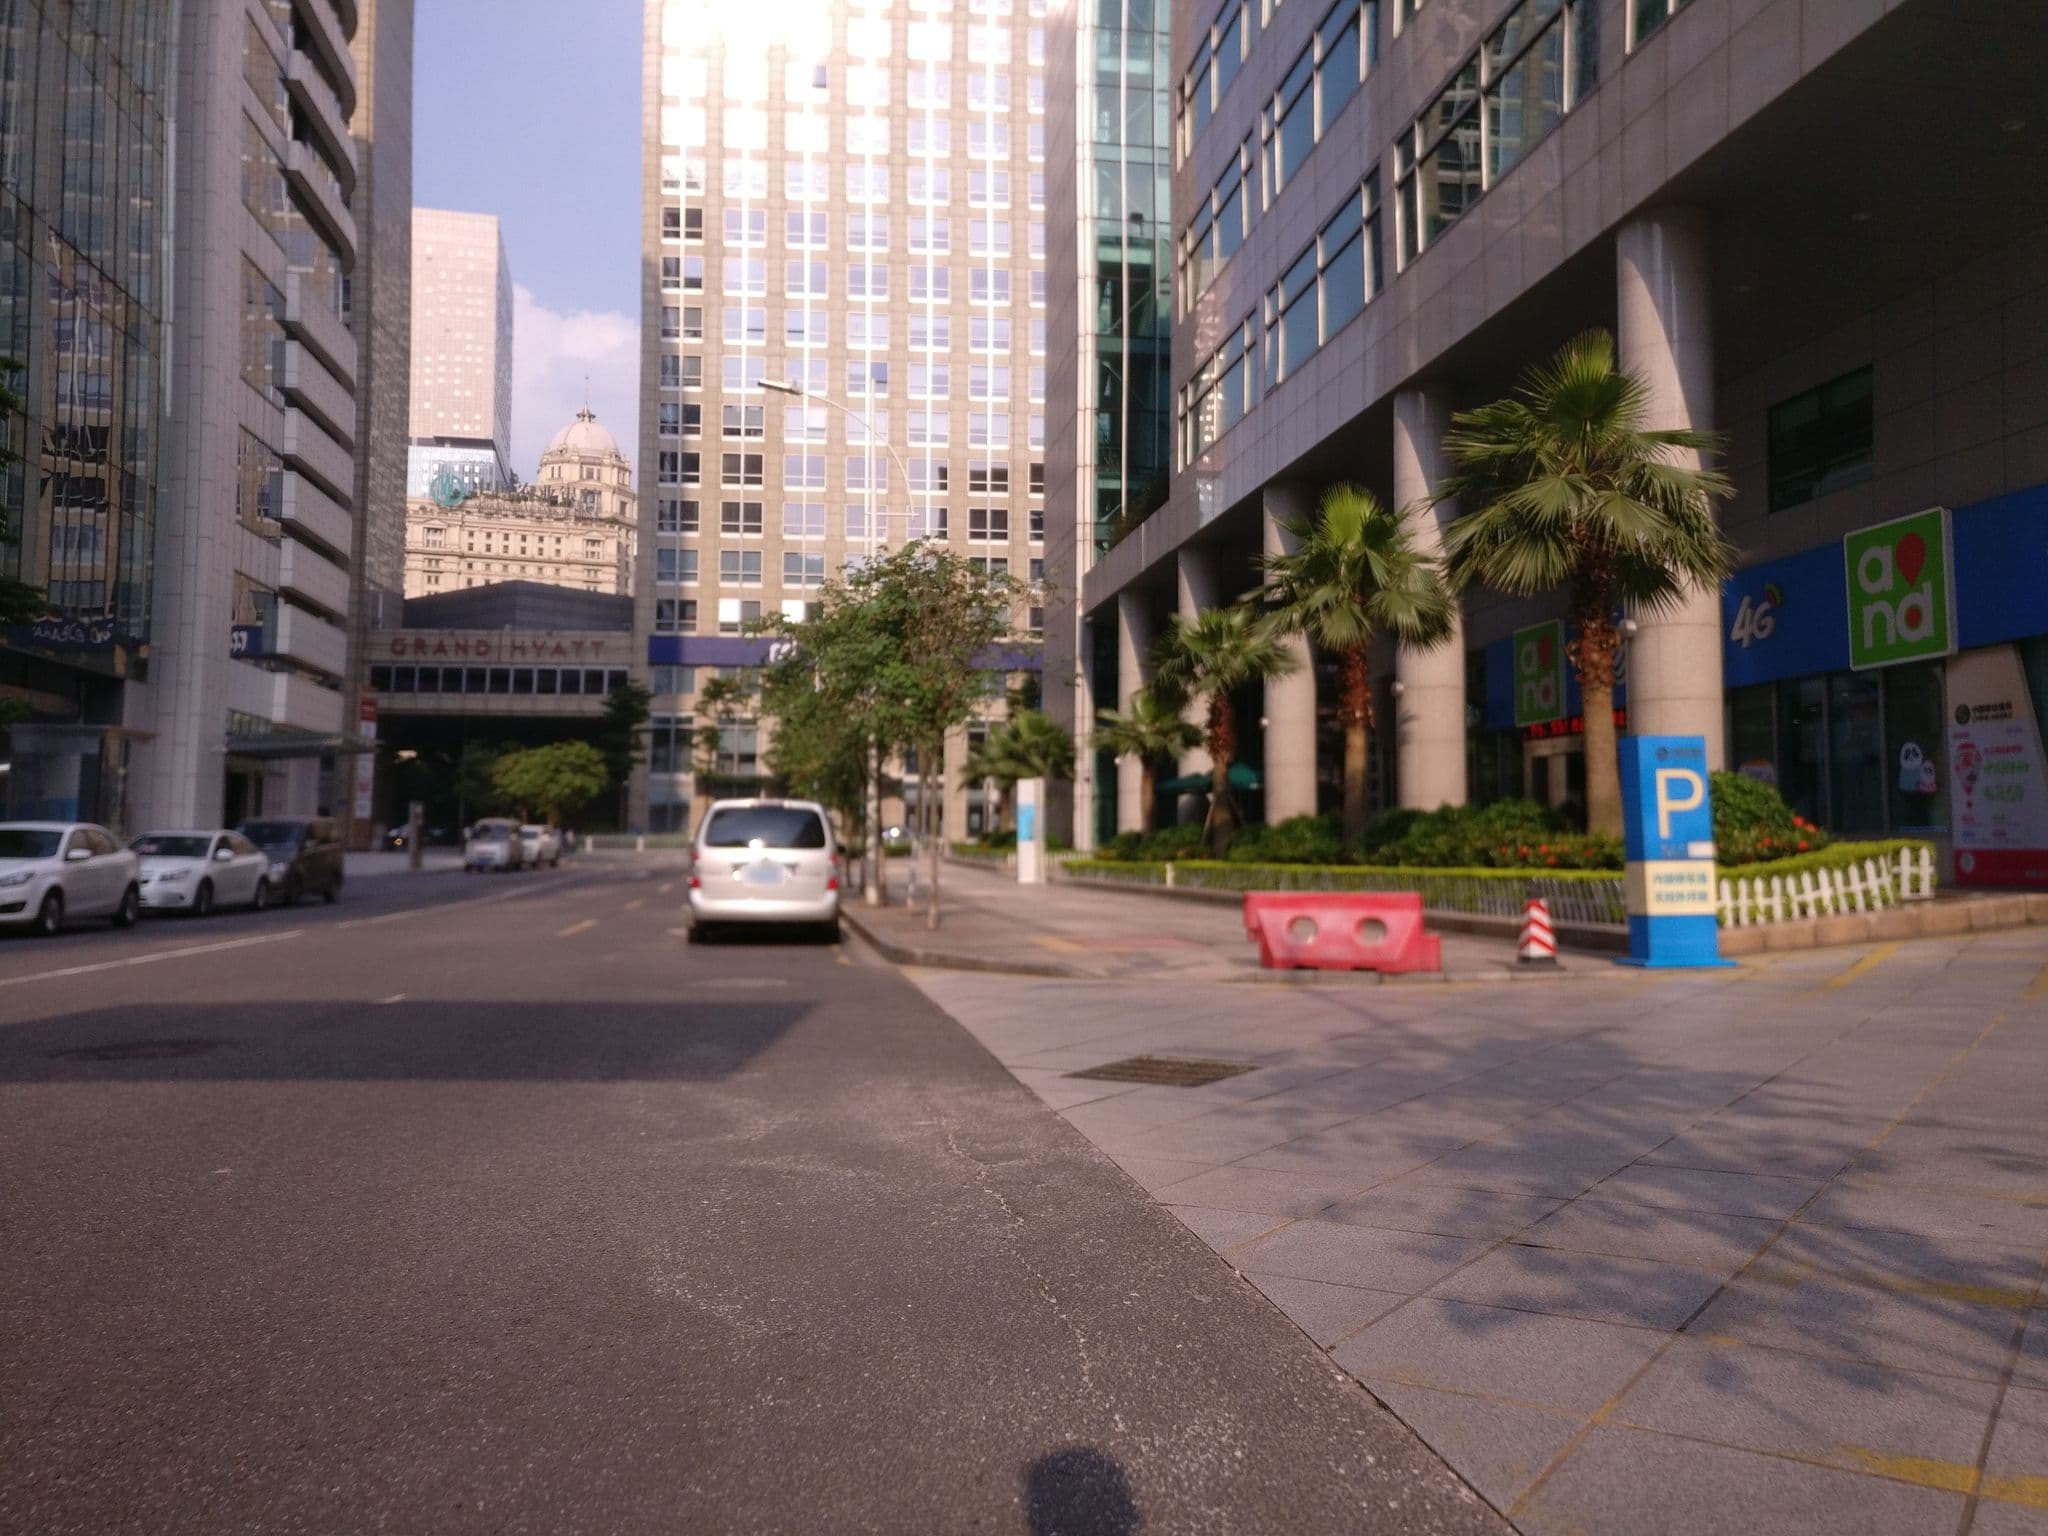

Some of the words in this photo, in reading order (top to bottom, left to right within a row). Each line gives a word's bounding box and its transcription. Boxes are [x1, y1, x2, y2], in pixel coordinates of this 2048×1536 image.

[390, 636, 490, 657] GRAND
[510, 638, 606, 659] HYATT
[1730, 595, 1776, 649] 4G
[1655, 768, 1705, 839] P
